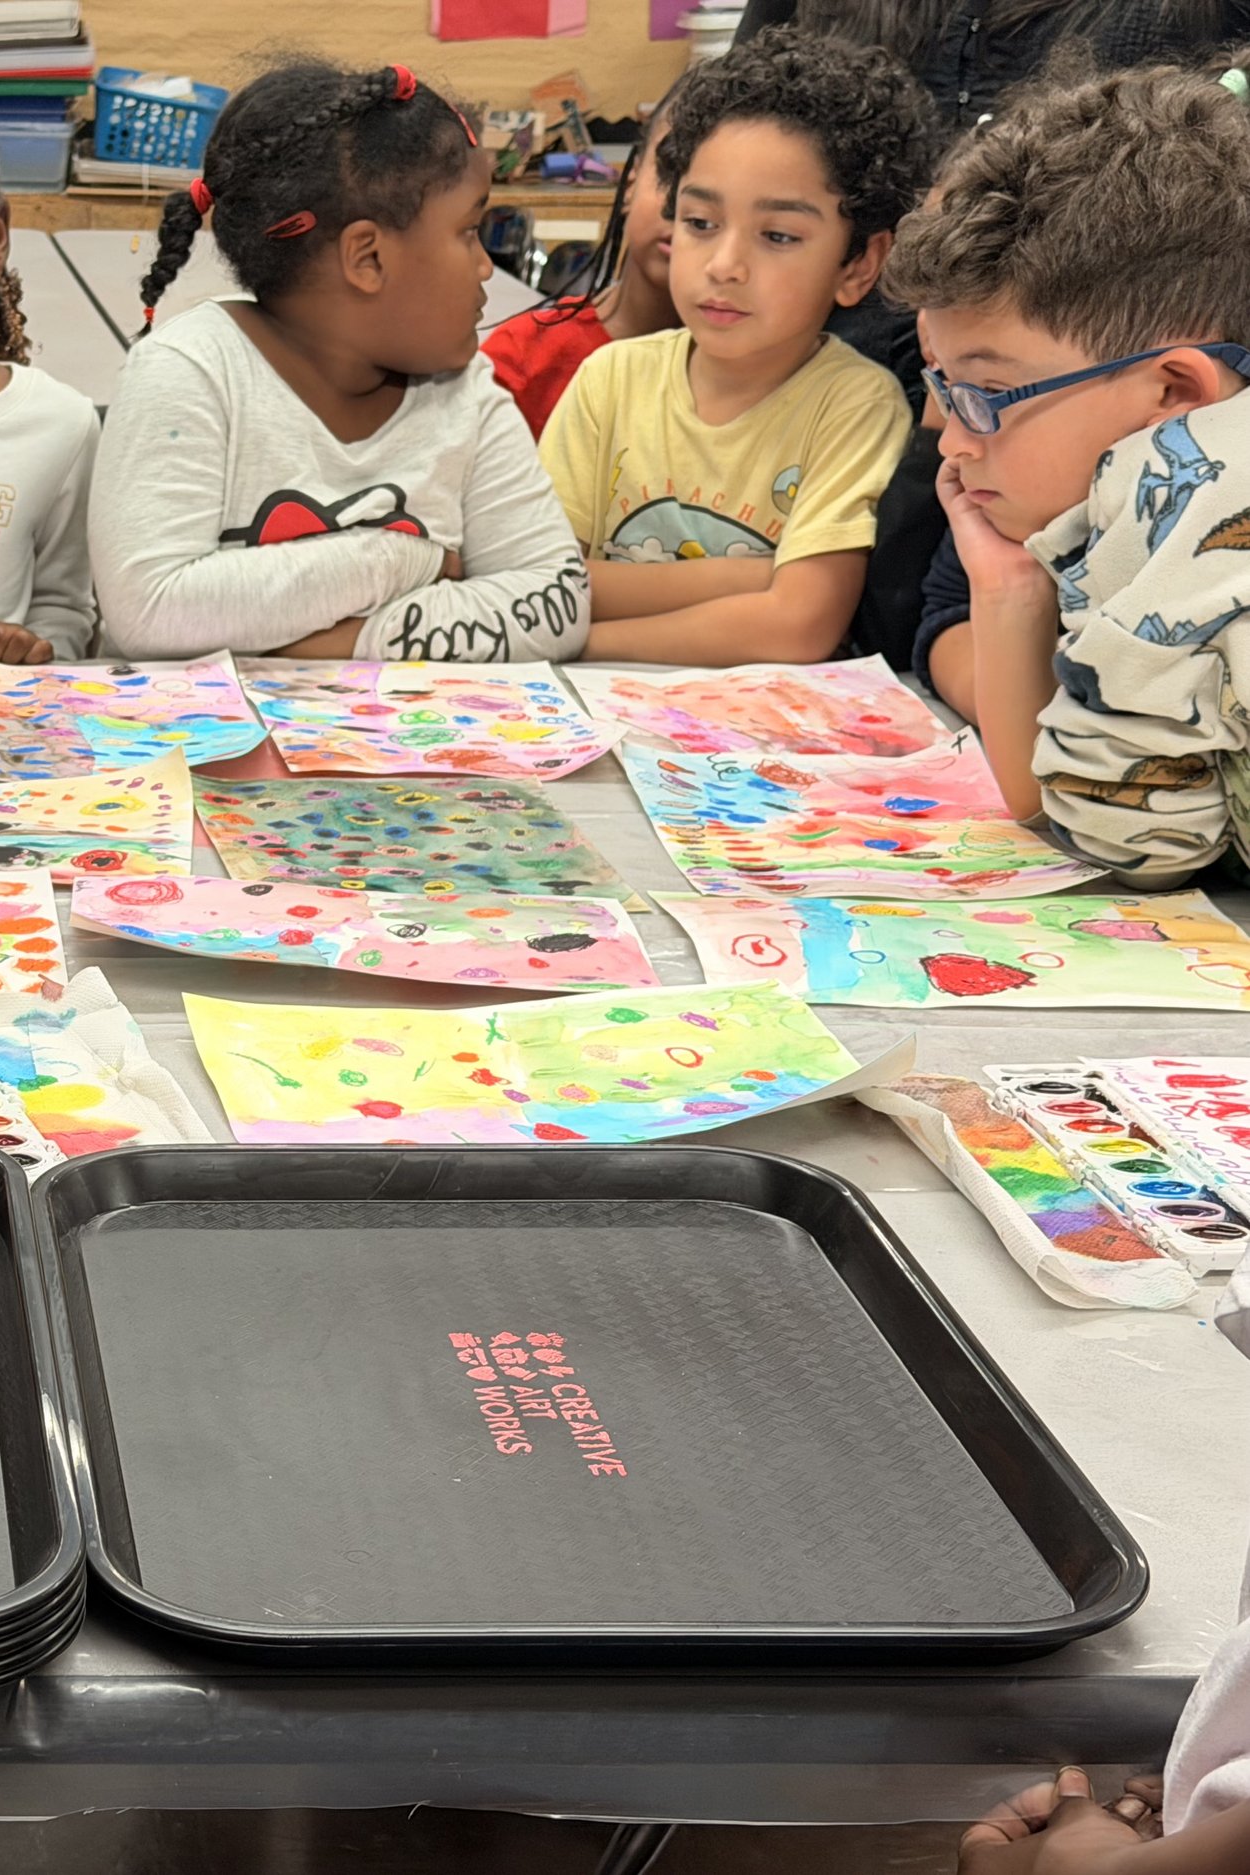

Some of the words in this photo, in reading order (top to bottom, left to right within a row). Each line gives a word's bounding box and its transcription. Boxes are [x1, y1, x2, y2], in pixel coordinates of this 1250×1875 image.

[473, 1386, 533, 1454] WORKS
[509, 1384, 558, 1419] ART
[551, 1383, 627, 1477] CREATIVE
